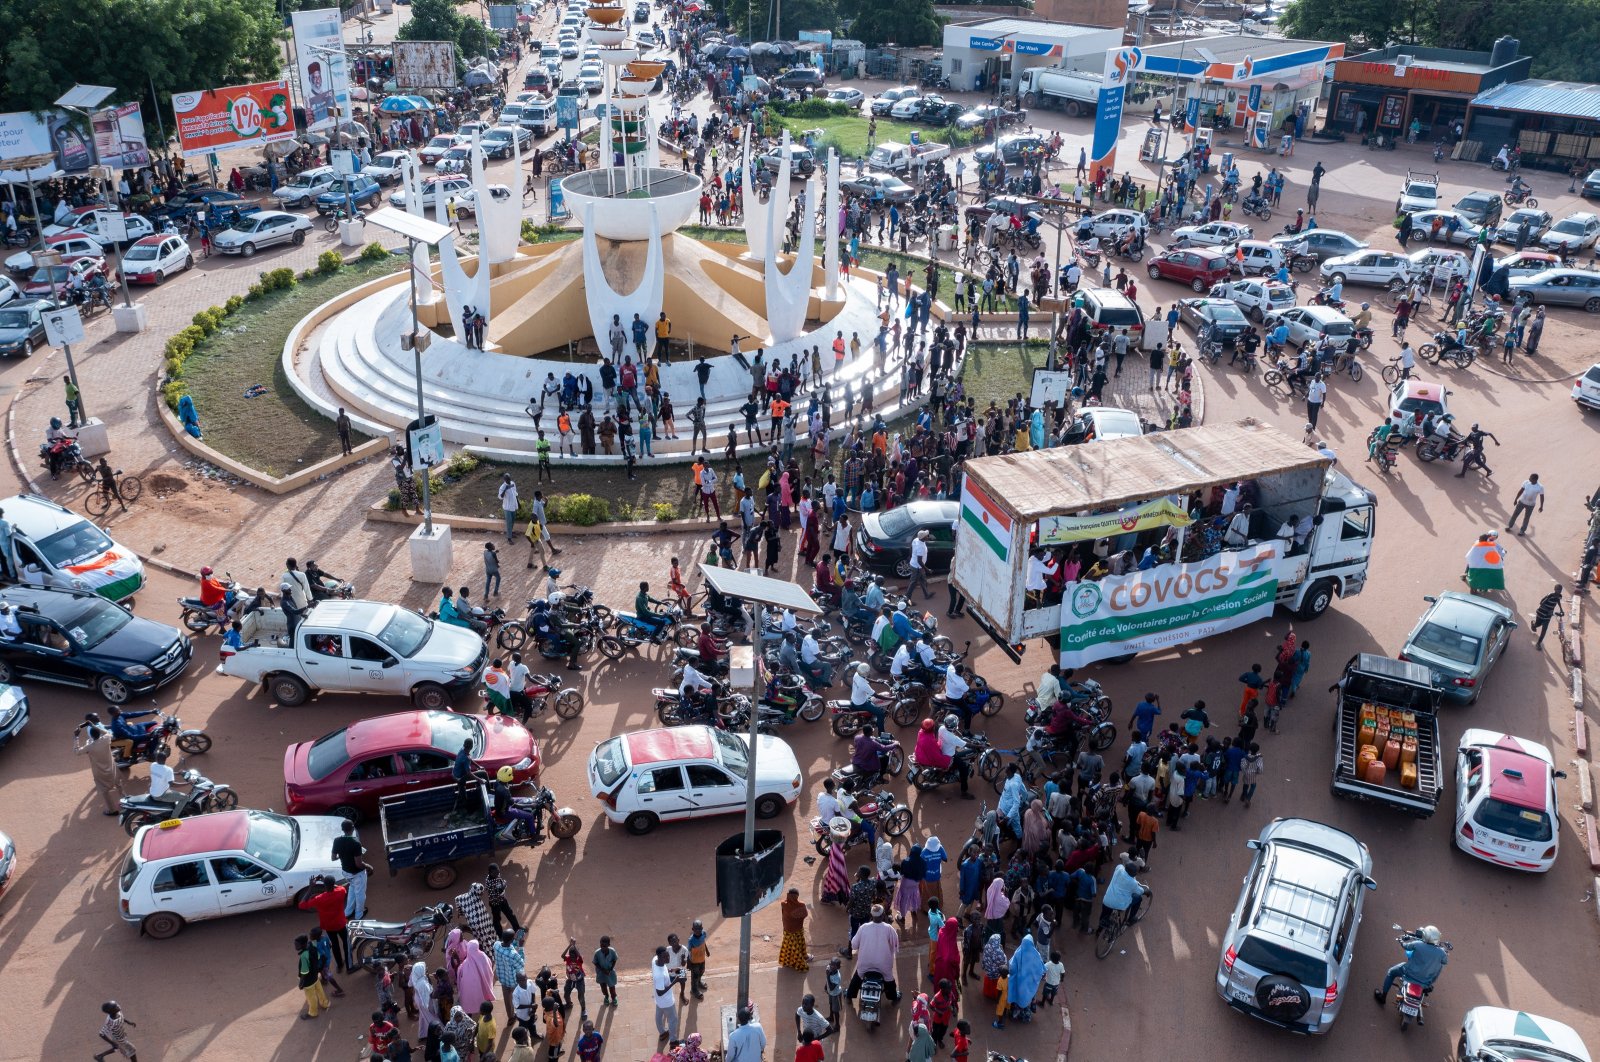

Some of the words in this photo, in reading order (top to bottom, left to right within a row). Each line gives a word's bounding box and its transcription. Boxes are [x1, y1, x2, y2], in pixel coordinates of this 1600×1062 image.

[234, 102, 260, 130] 1%
[1100, 518, 1121, 528] QUITTEZ
[1109, 566, 1230, 611] COVOCS
[1067, 629, 1097, 643] Comité
[1098, 627, 1116, 636] des
[1116, 617, 1167, 633] Volontaires
[1168, 612, 1191, 625] pour
[1191, 610, 1200, 618] la
[1242, 590, 1268, 606] Sociale
[1153, 632, 1190, 645] COHÉSION
[1198, 625, 1216, 635] PAIX
